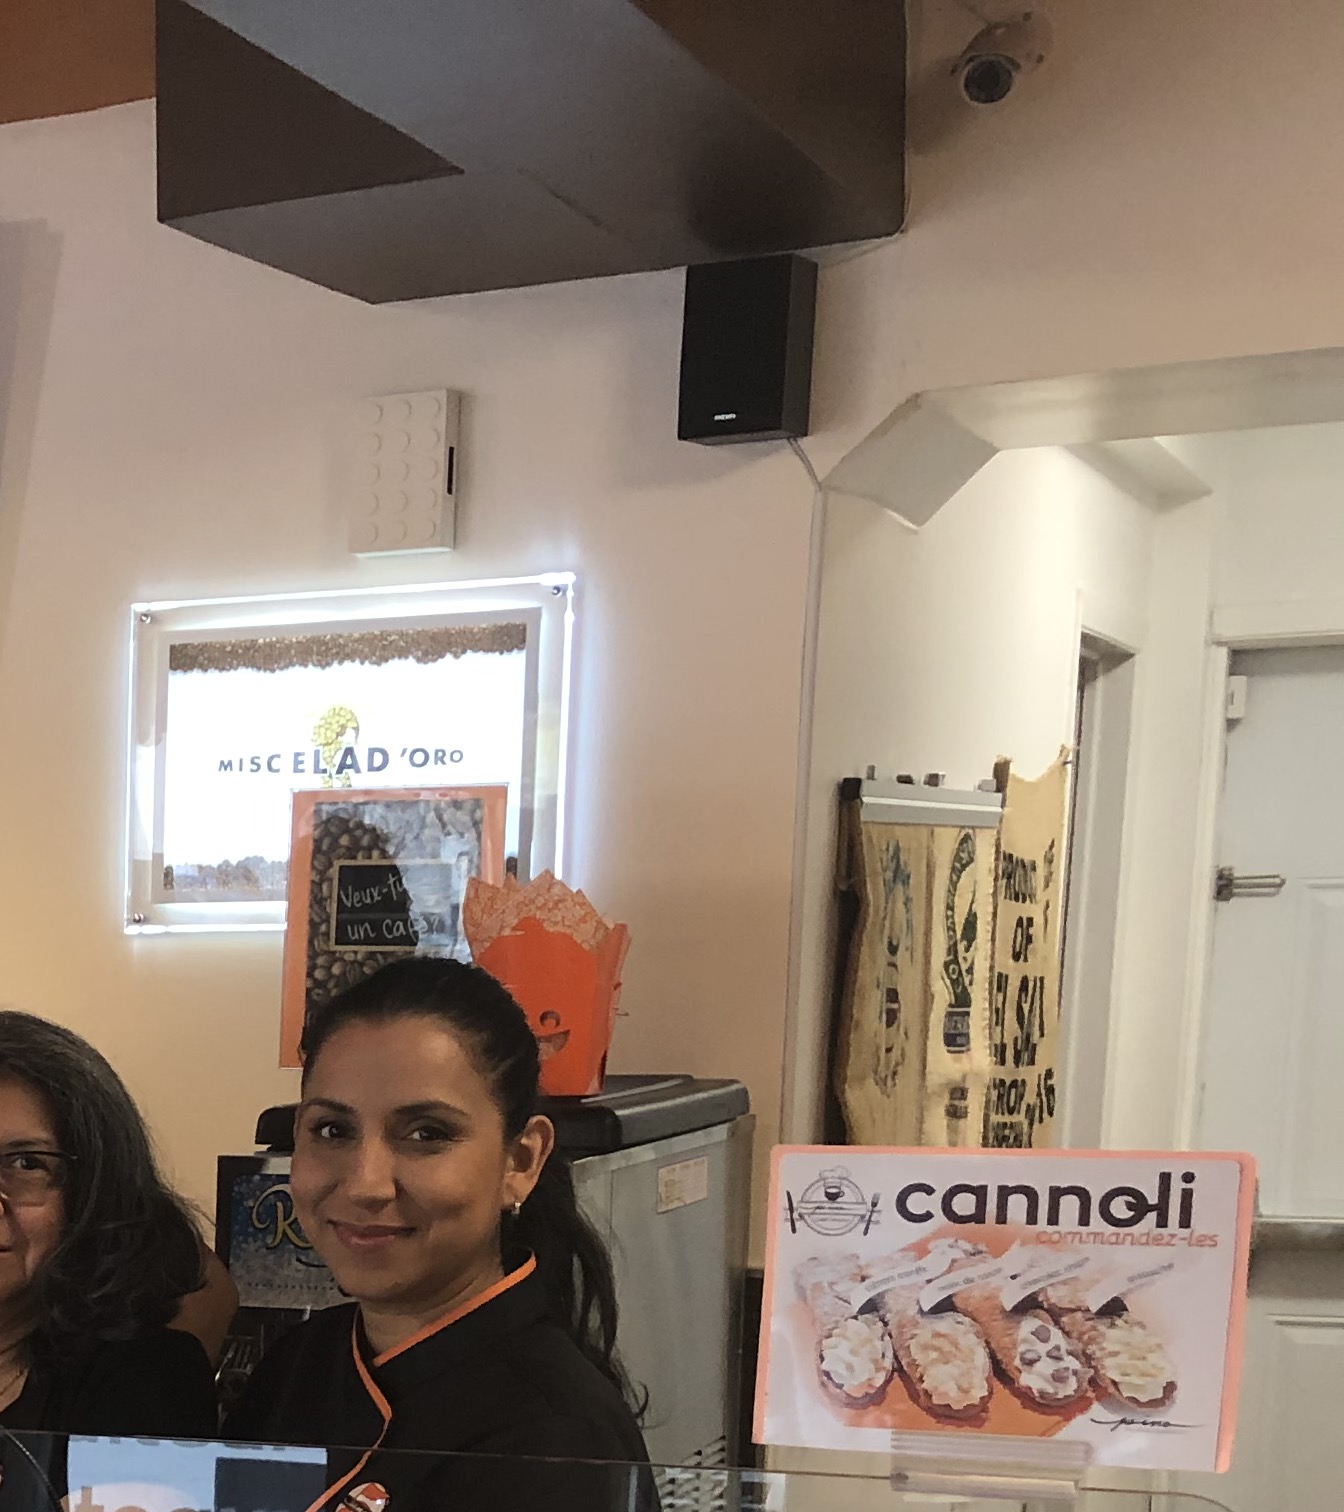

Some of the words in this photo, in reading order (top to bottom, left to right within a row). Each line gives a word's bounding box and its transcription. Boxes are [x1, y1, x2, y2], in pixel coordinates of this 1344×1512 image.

[347, 923, 377, 940] un
[894, 1170, 1196, 1229] cannoli
[1036, 1227, 1219, 1249] commandez-les
